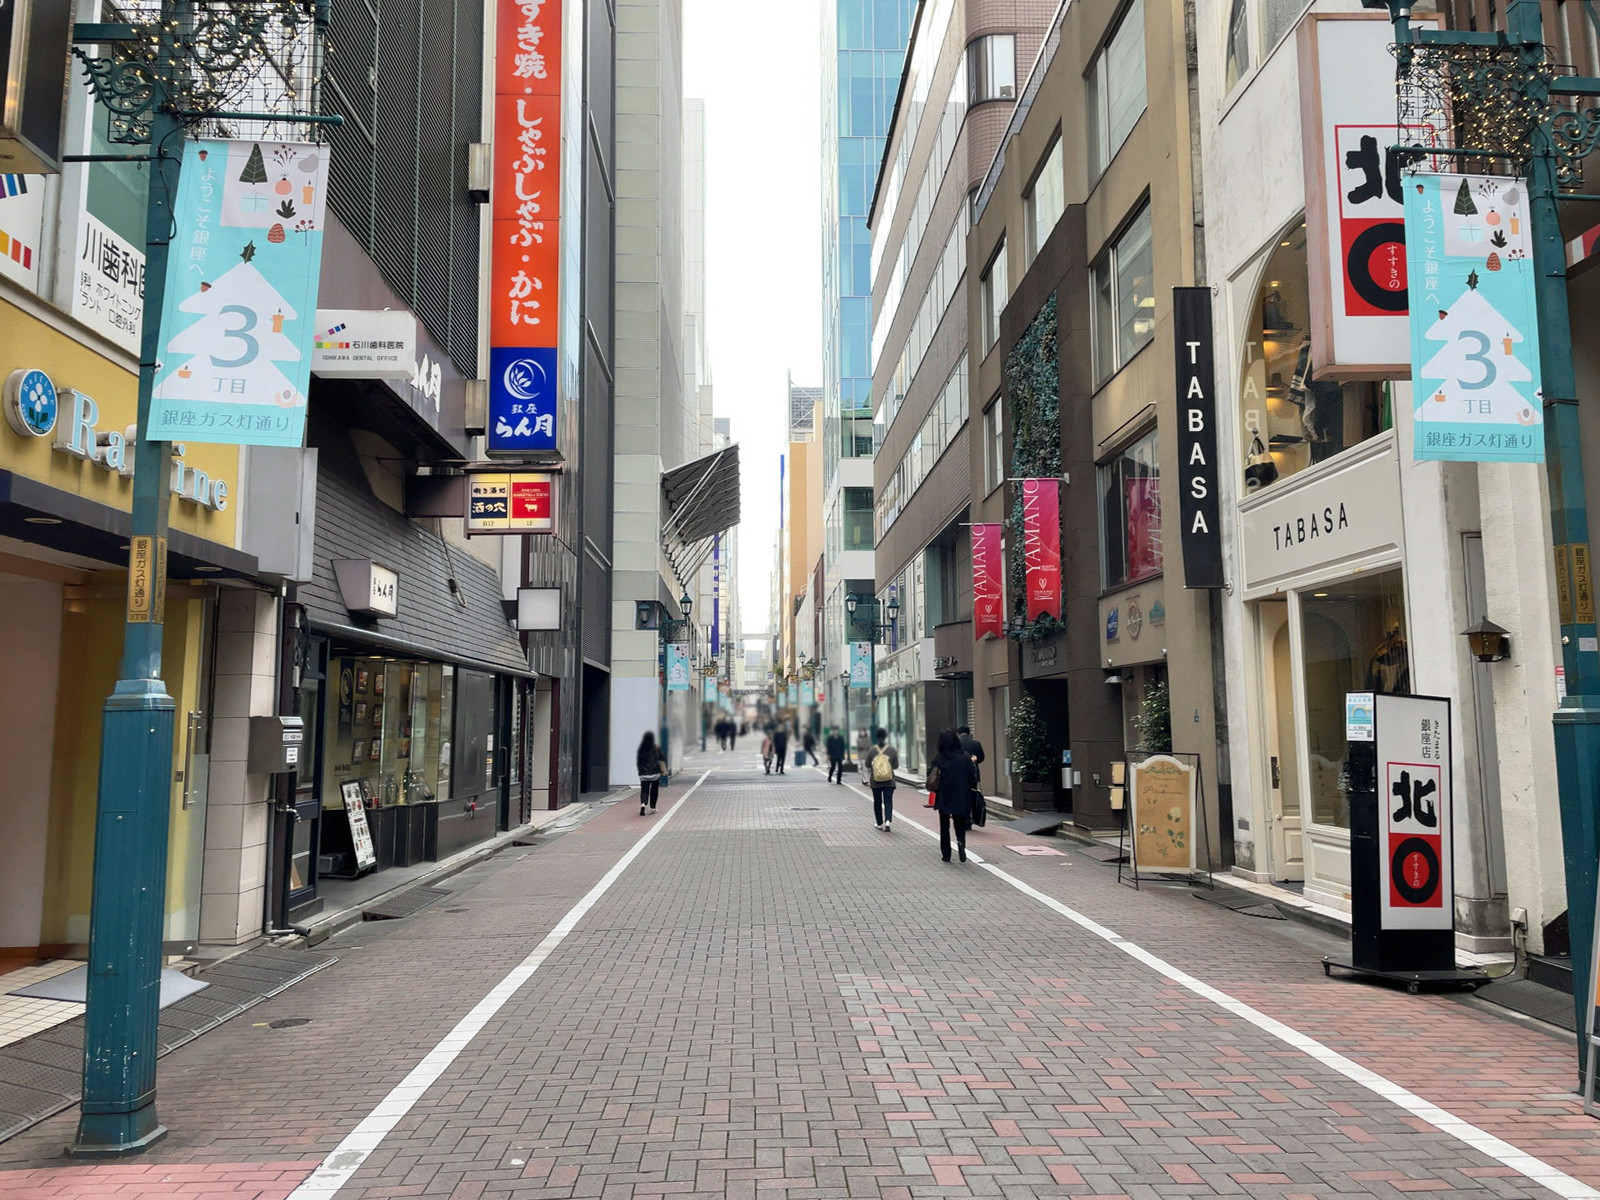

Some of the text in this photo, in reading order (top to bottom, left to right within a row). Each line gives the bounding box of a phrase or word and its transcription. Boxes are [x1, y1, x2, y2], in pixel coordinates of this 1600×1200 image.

[187, 167, 216, 277] ようこそ銀座へ
[1387, 245, 1401, 289] すすきの
[1422, 200, 1442, 305] ようこそ銀座へ
[209, 304, 260, 369] 3
[352, 341, 405, 350] 石川歯科医院
[1456, 329, 1498, 391] 3
[213, 376, 246, 395] 丁目
[1464, 399, 1492, 415] 丁目
[161, 409, 290, 432] 銀座ガス灯通り
[495, 413, 554, 438] らん月
[1185, 341, 1209, 534] TABASA
[1426, 431, 1533, 449] 銀座ガス灯通り
[472, 501, 507, 514] 酒の穴
[1022, 477, 1041, 575] YAMANO
[1273, 502, 1348, 551] TABASA
[972, 522, 987, 602] YAMANO
[1421, 718, 1432, 759] 銀座店
[1392, 770, 1438, 828] 北
[1412, 853, 1421, 887] すすきの
